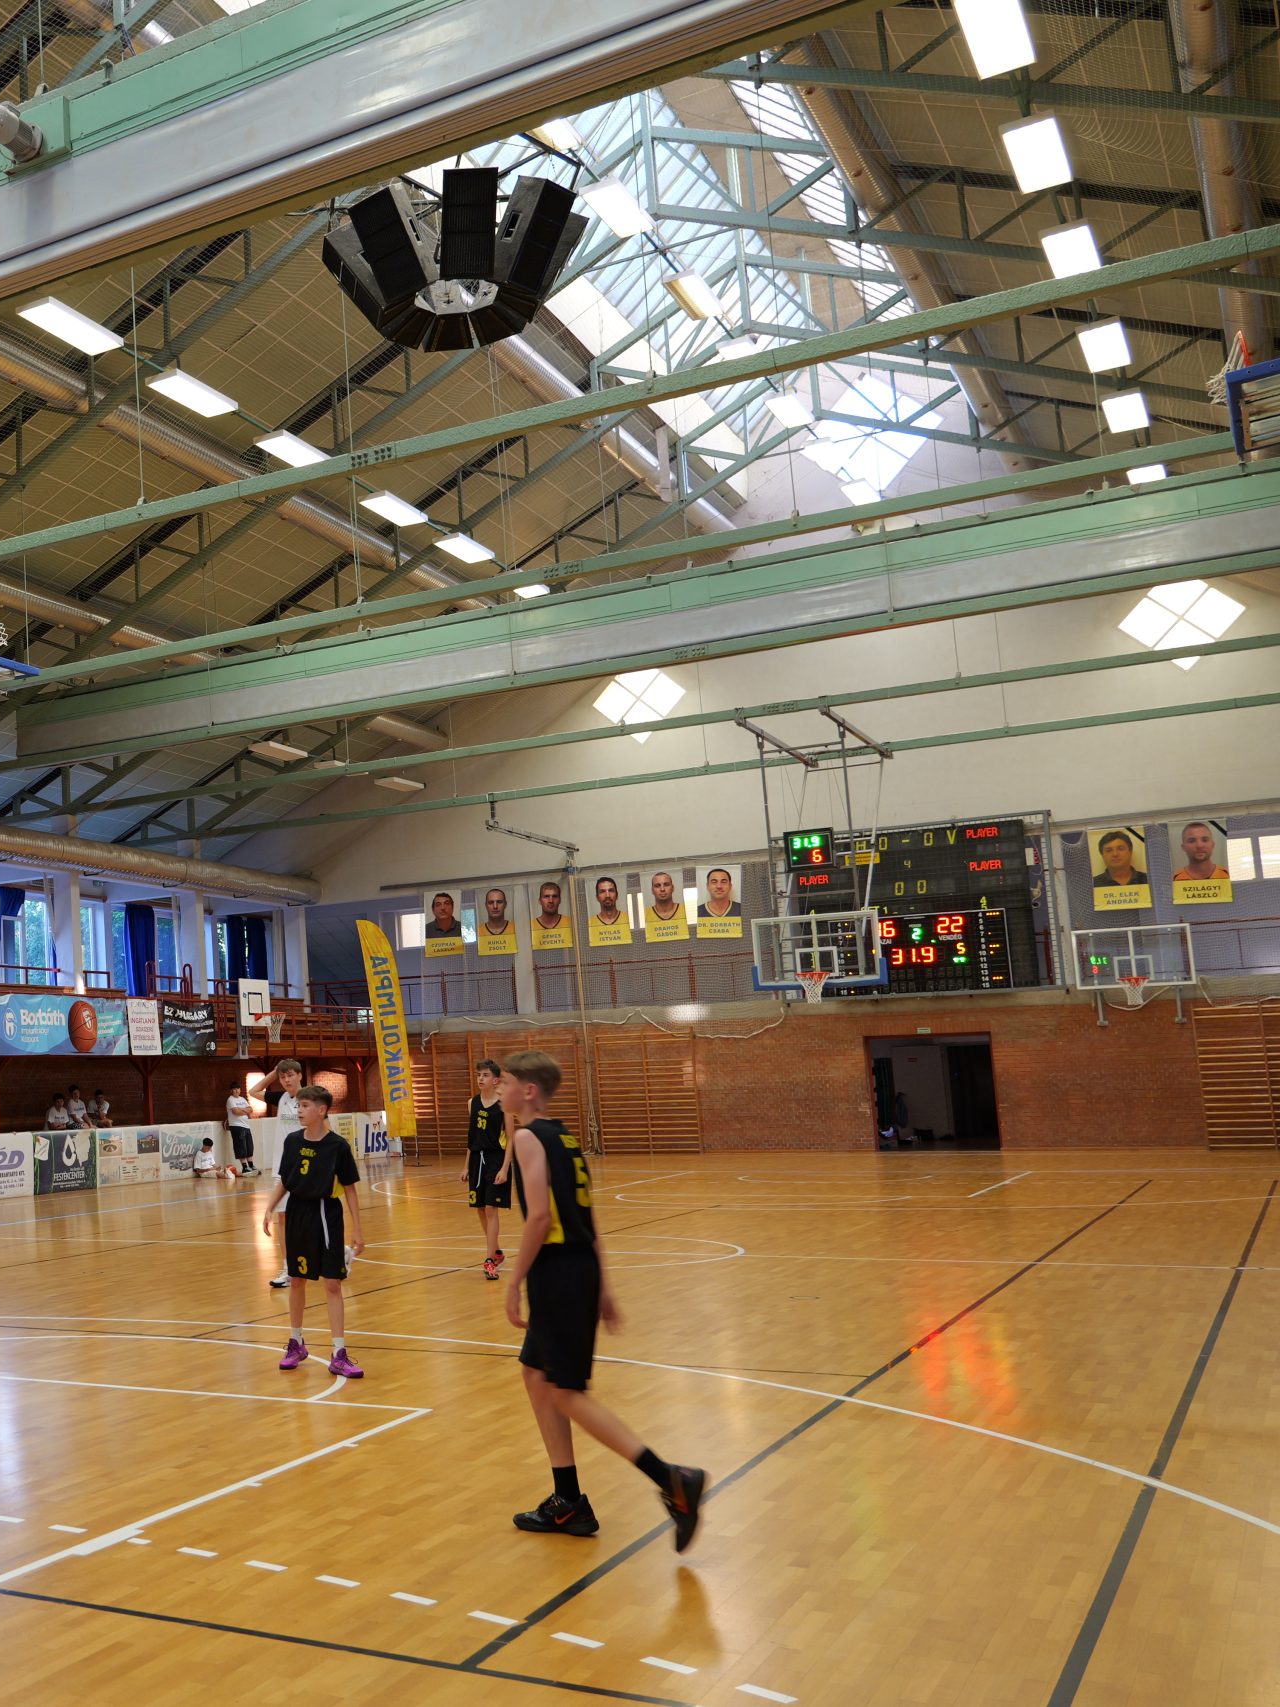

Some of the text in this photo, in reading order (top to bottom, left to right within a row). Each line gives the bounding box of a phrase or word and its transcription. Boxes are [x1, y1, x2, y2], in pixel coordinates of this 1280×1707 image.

[966, 827, 998, 839] PLAYER
[792, 836, 821, 848] 31.9
[812, 849, 822, 862] 6
[969, 860, 1001, 871] PLAYER
[800, 875, 829, 885] PLAYER
[937, 916, 964, 933] 22
[911, 928, 922, 940] 2
[892, 946, 934, 965] 31.9
[477, 1117, 487, 1130] 33
[163, 1133, 195, 1158] Ford
[300, 1159, 310, 1175] 3
[297, 1256, 308, 1275] 3
